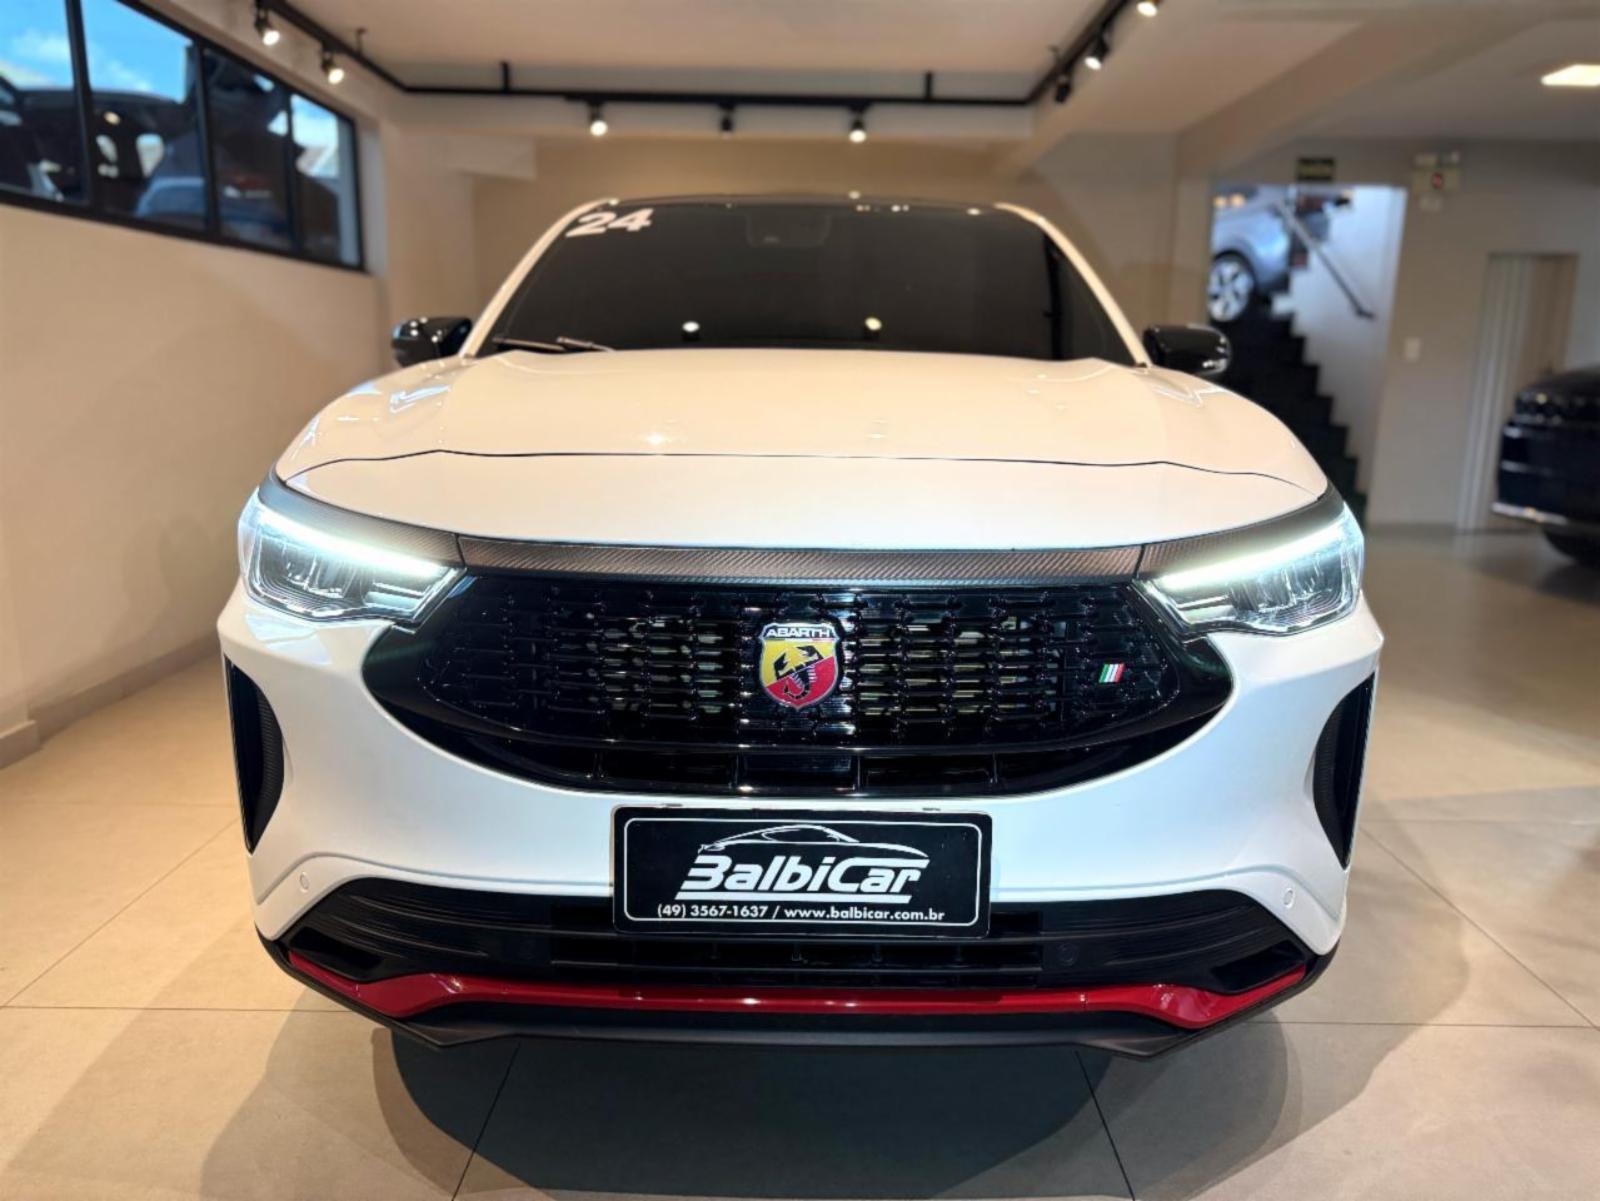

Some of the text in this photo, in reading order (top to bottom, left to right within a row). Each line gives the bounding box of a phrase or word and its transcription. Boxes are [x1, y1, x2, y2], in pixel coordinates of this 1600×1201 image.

[565, 208, 654, 238] 24
[766, 627, 830, 638] ABARTH
[680, 854, 930, 893] BalbiCar
[657, 904, 945, 921] (49) 3567-1637 / www.balbicar.com.br
